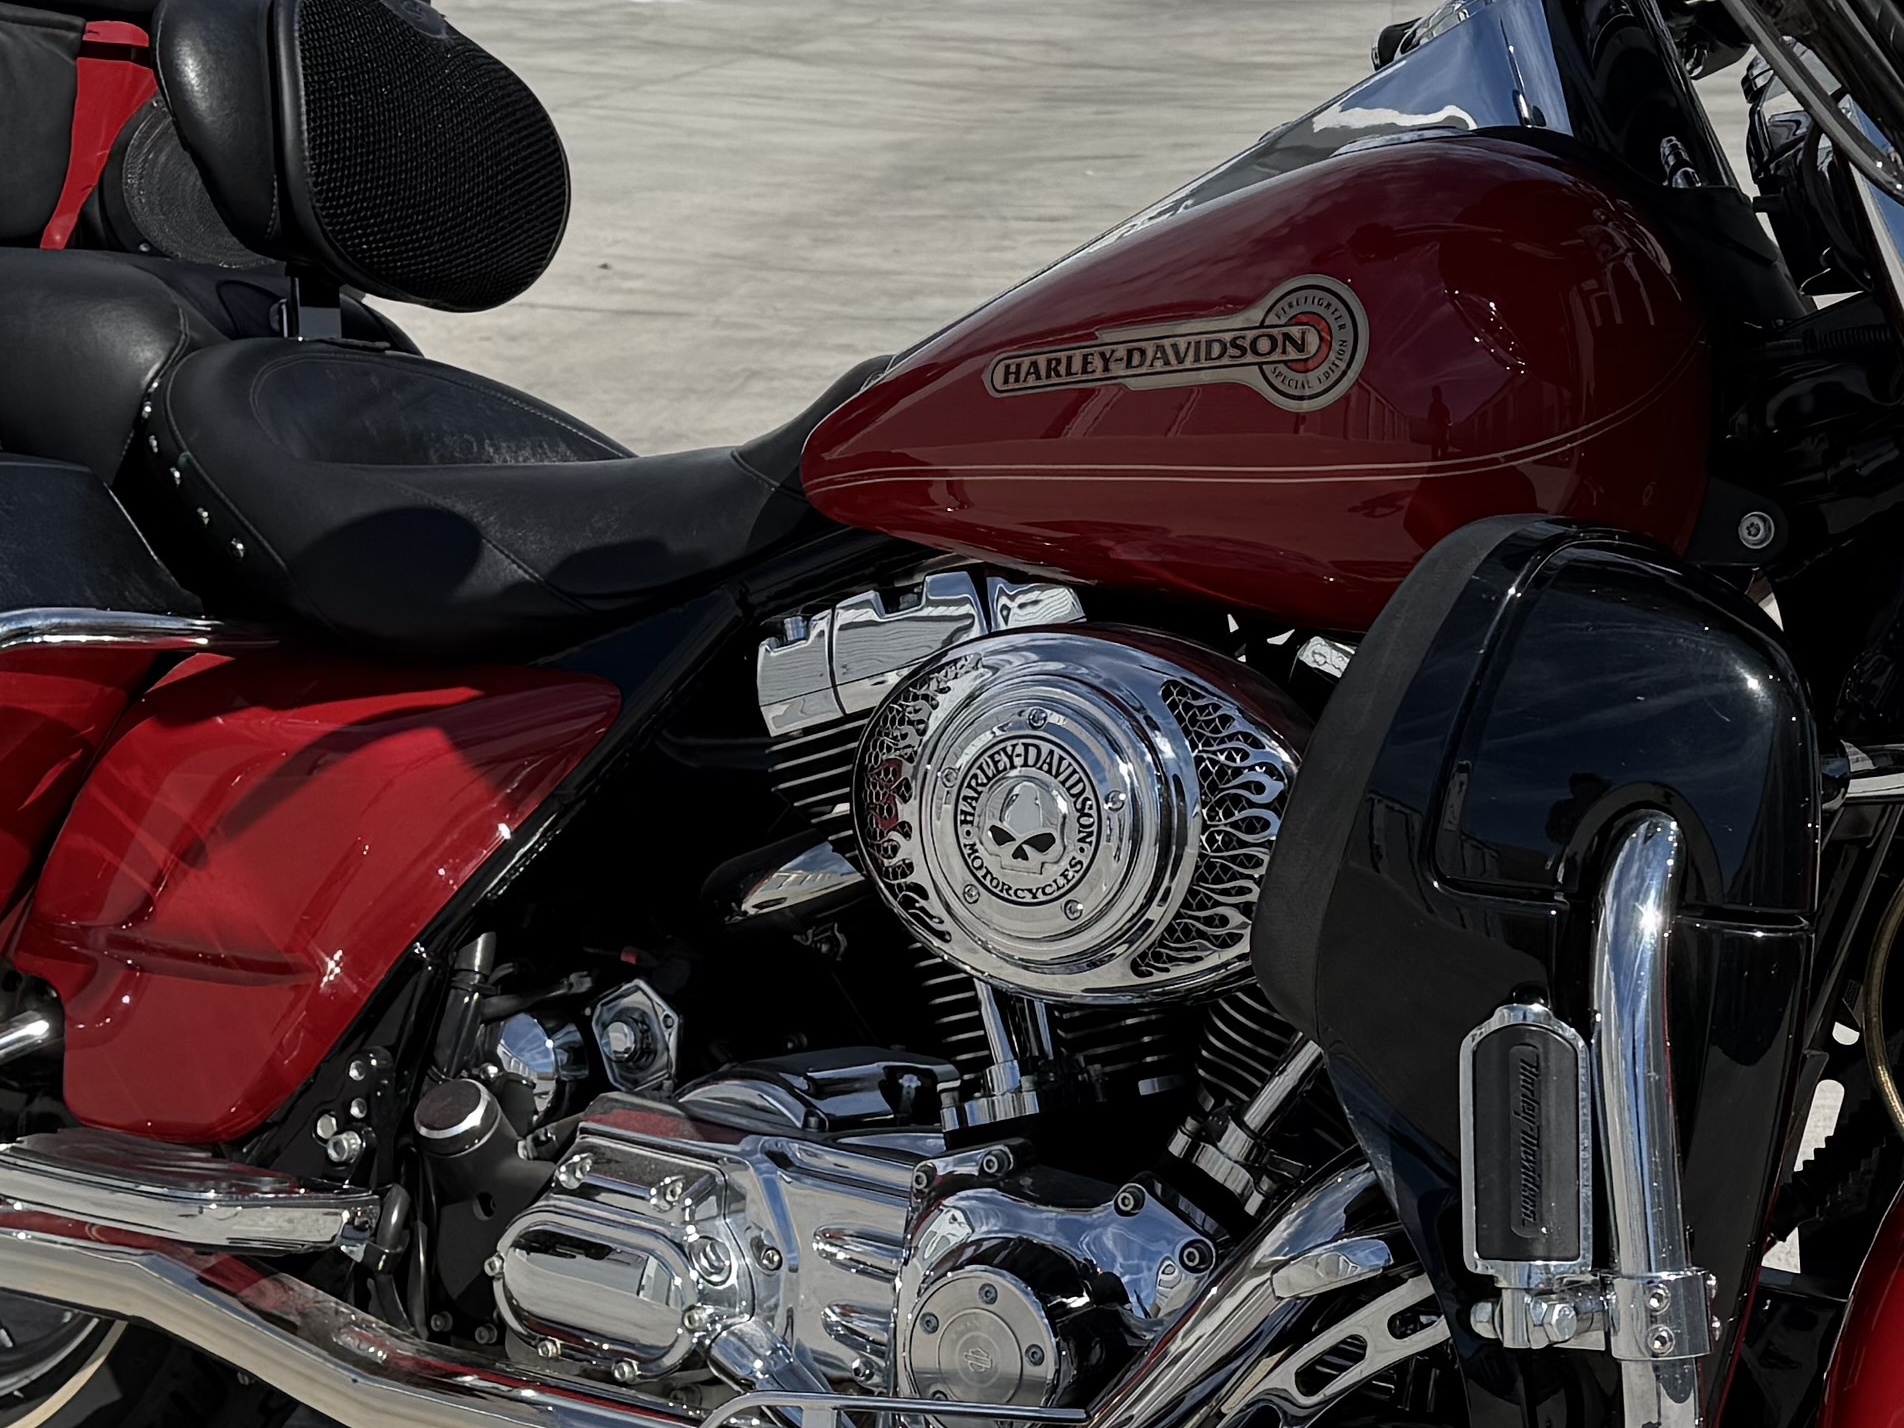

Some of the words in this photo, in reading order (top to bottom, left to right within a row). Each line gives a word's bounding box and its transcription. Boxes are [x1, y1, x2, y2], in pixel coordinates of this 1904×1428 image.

[1002, 329, 1308, 386] HARLEY-DAVIDSON
[960, 742, 1095, 847] HARLEY-DAVIDSON
[963, 842, 1084, 900] MOTORCYCLES
